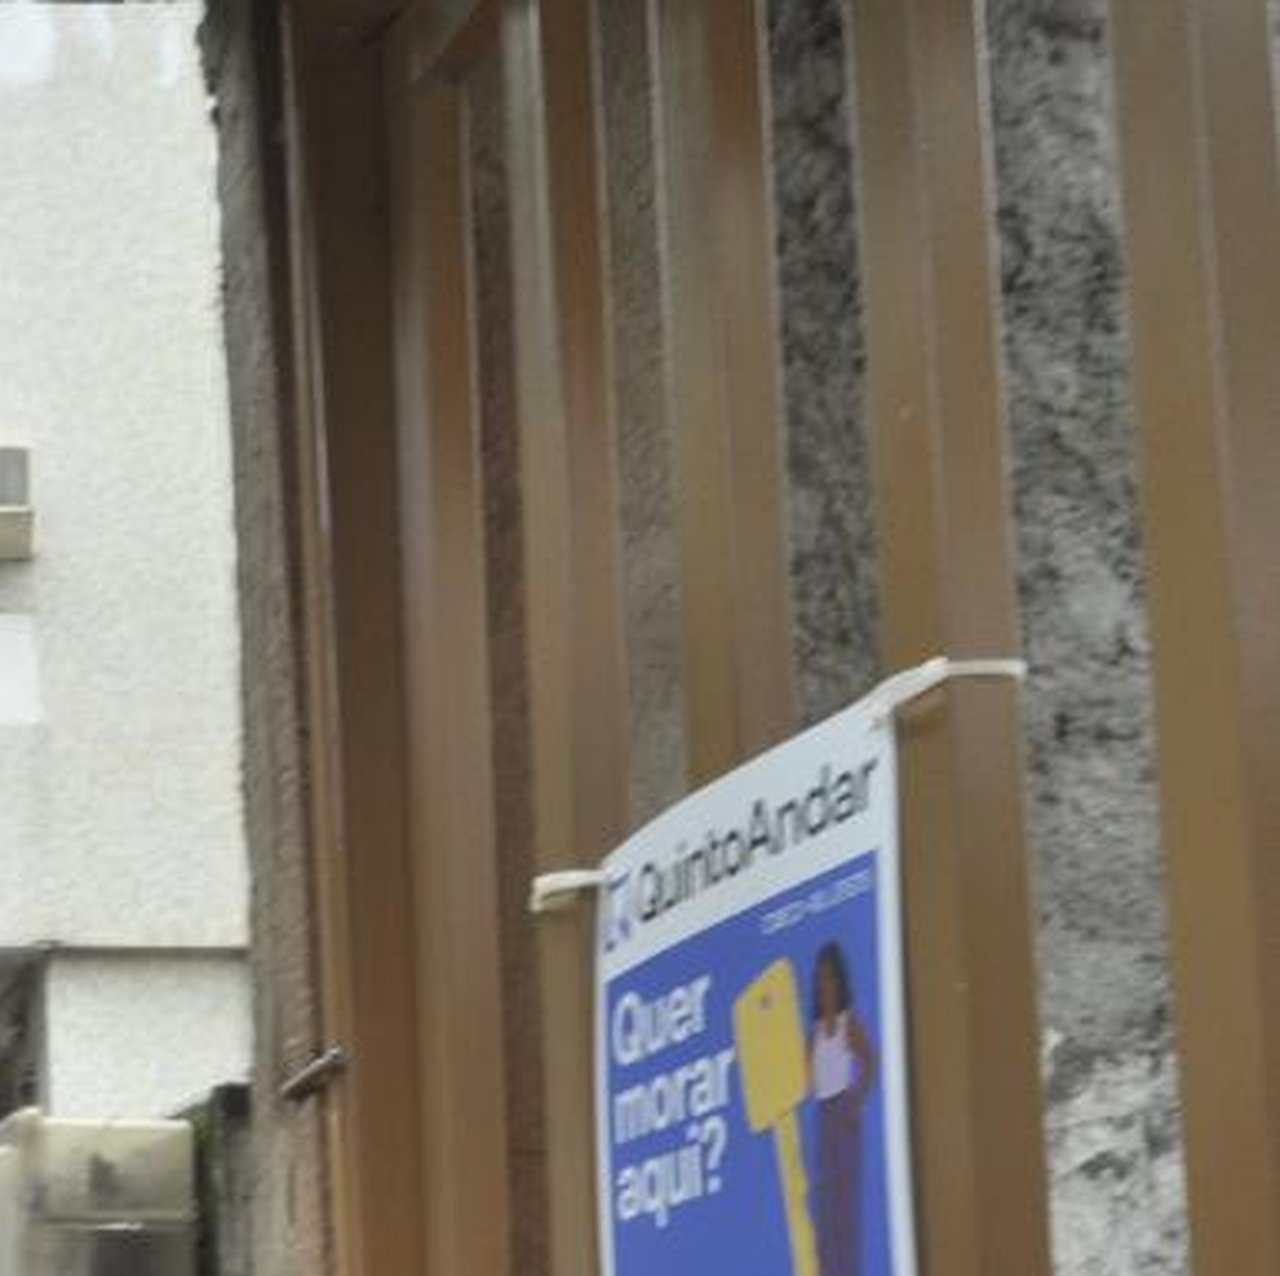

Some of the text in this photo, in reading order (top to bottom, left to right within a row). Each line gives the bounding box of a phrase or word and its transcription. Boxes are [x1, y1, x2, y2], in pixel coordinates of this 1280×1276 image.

[639, 757, 878, 922] QuintoAndar
[613, 974, 711, 1066] Quer
[614, 1048, 736, 1144] morar
[617, 1115, 727, 1228] aqui?
